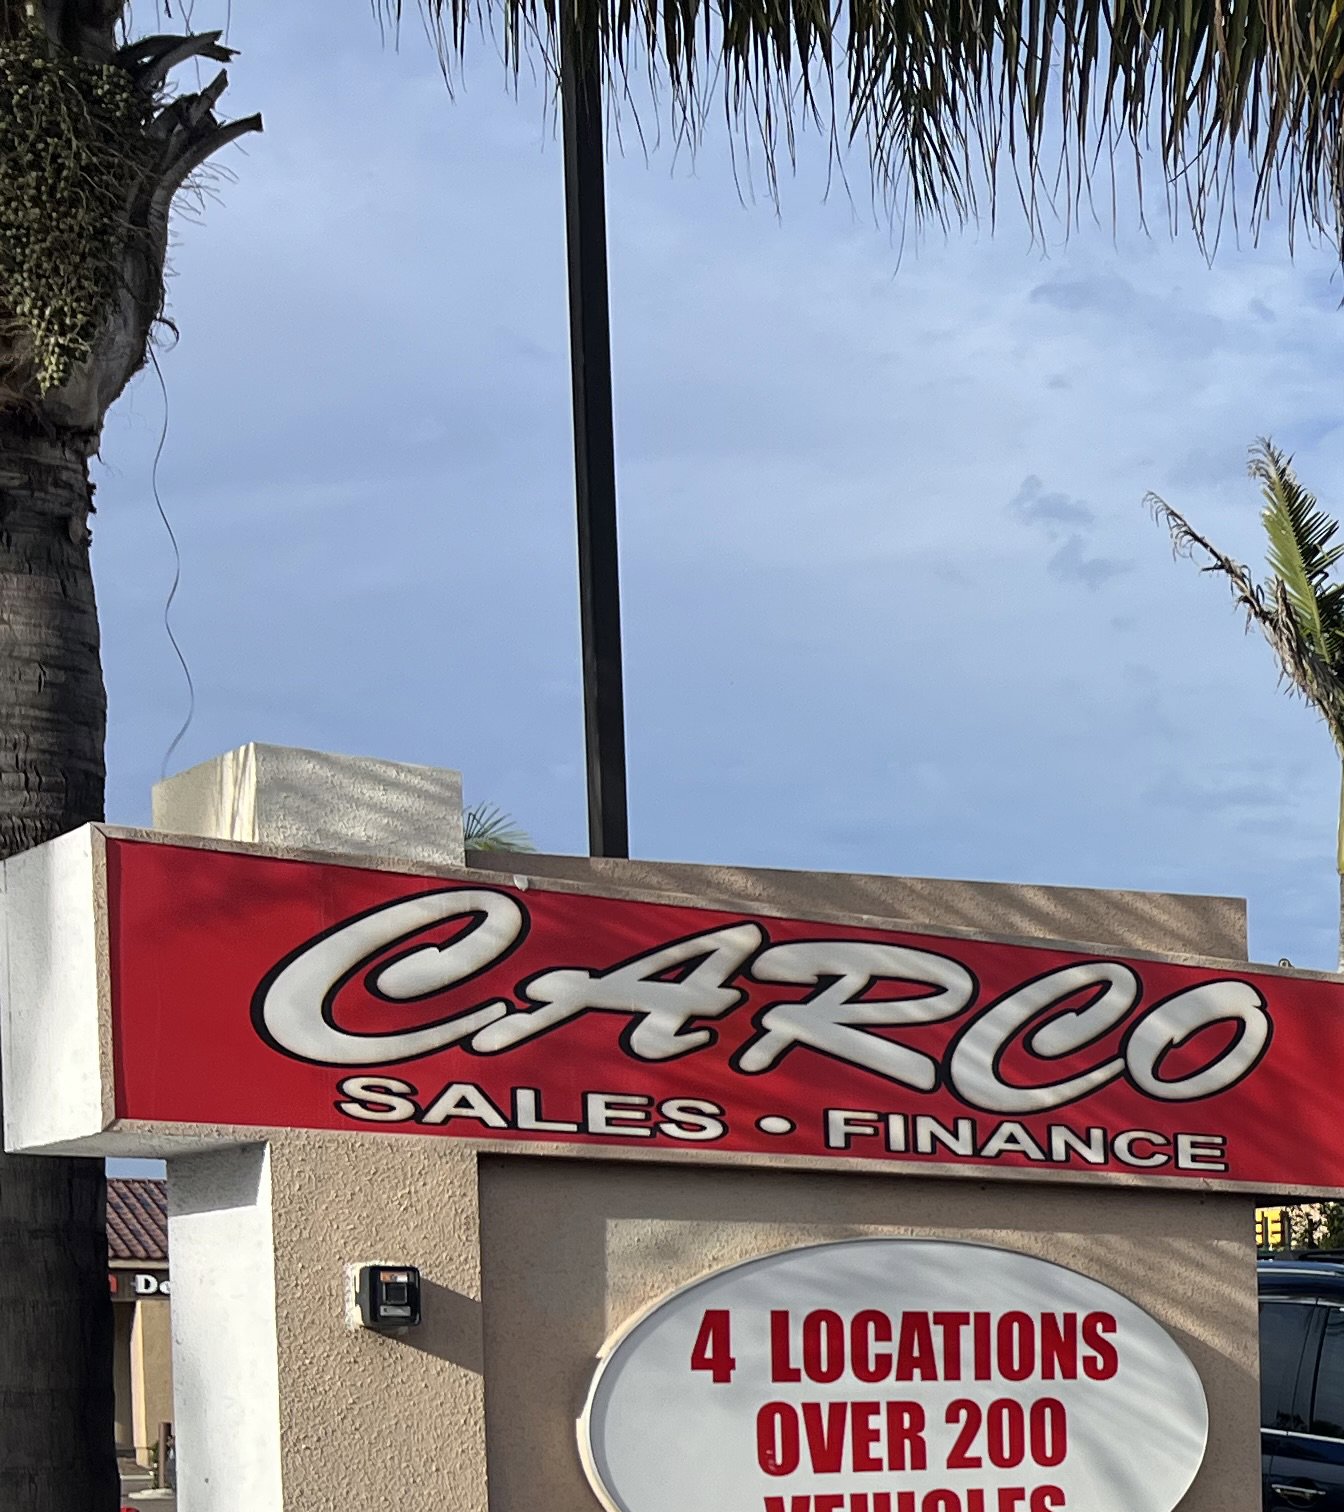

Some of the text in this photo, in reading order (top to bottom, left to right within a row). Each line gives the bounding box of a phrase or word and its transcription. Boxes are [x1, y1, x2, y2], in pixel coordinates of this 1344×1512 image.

[251, 886, 1272, 1114] CARCO
[337, 1074, 1229, 1173] SALES FINANCE
[690, 1309, 1118, 1383] 4 LOCATIONS
[756, 1398, 1068, 1476] OVER 200
